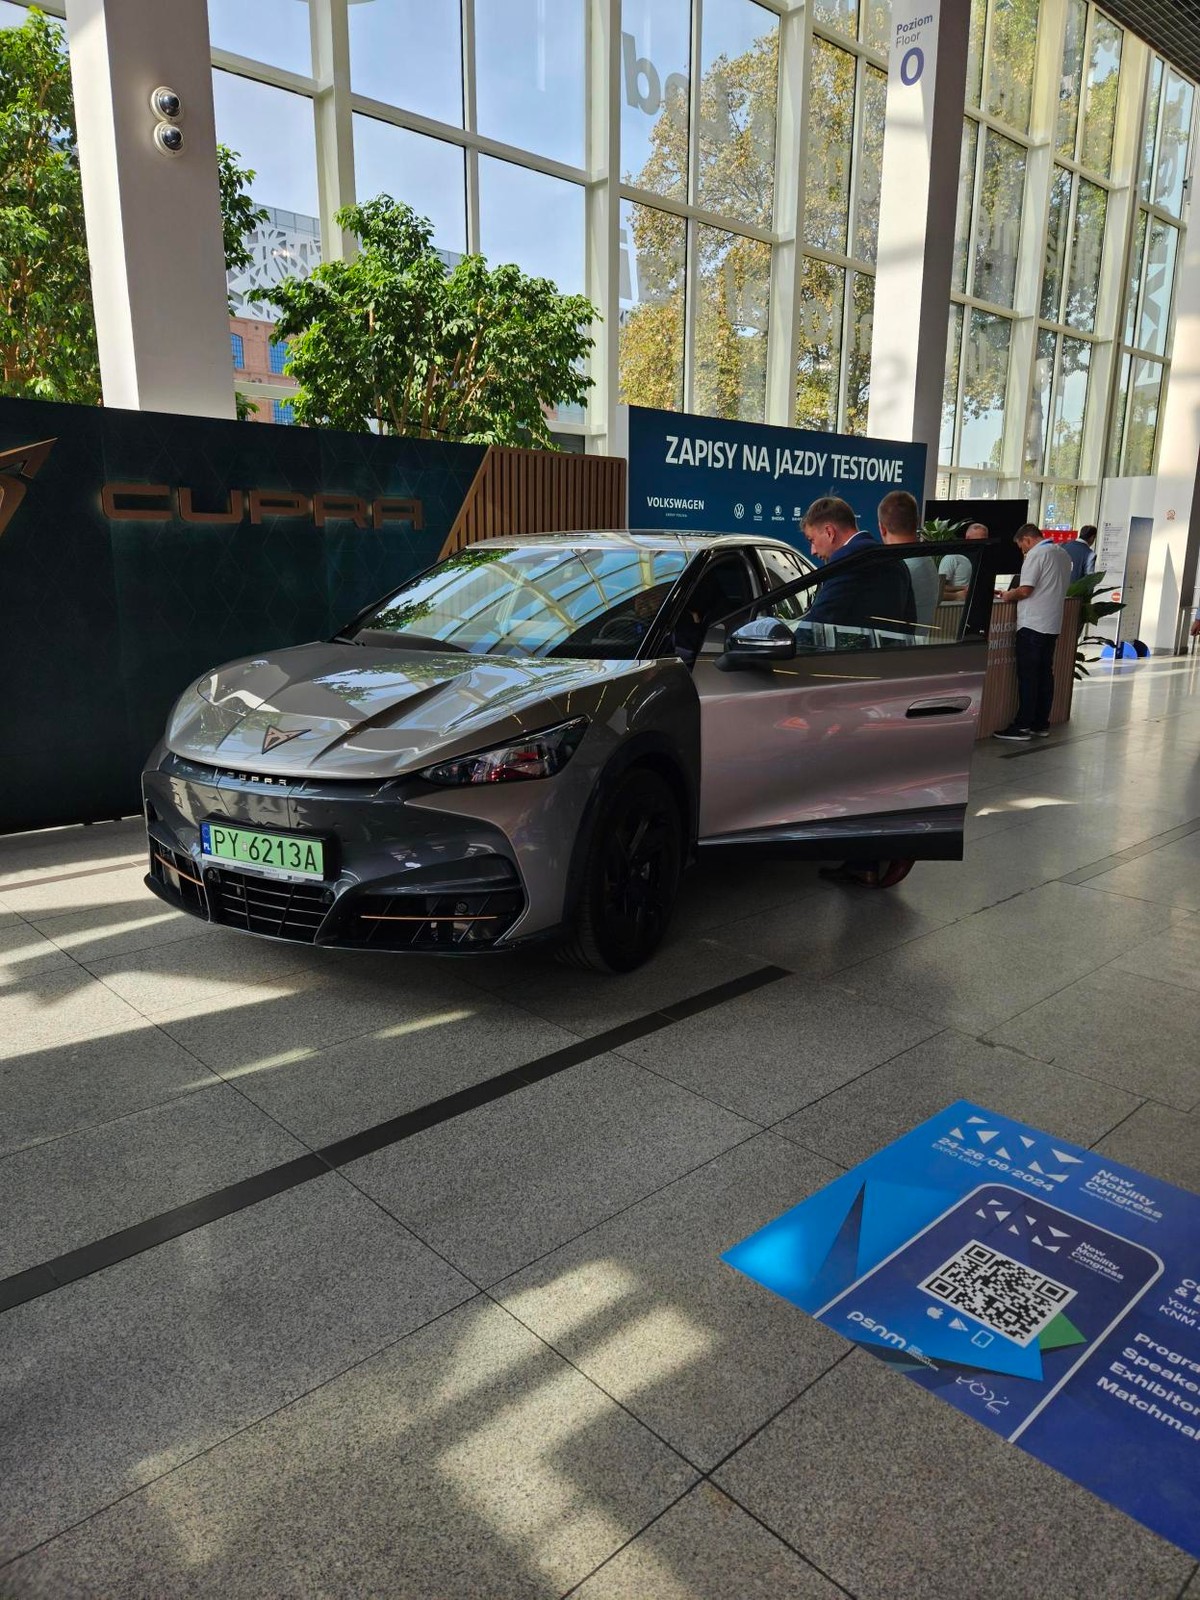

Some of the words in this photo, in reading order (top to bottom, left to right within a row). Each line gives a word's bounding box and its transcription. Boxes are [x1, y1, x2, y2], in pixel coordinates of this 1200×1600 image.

[897, 15, 933, 35] Poziom
[896, 32, 921, 48] Floor
[665, 435, 737, 469] ZAPISY
[743, 444, 770, 473] NA
[773, 448, 827, 480] JAZDY
[831, 454, 903, 483] TESTOWE
[101, 484, 424, 530] CUPRA
[646, 496, 705, 510] VOLKSWAGEN
[214, 829, 239, 857] PY
[249, 836, 317, 872] 6213A
[1090, 1175, 1156, 1206] Mobility
[1097, 1169, 1135, 1188] New
[1085, 1182, 1163, 1218] Congress
[1075, 1246, 1120, 1270] Mobility
[1080, 1242, 1106, 1257] New
[1071, 1251, 1124, 1280] Congress
[1174, 1286, 1189, 1298] &
[1159, 1304, 1196, 1326] KNM
[1169, 1296, 1199, 1316] Your
[847, 1311, 907, 1349] psnm
[1122, 1347, 1200, 1396] Speake
